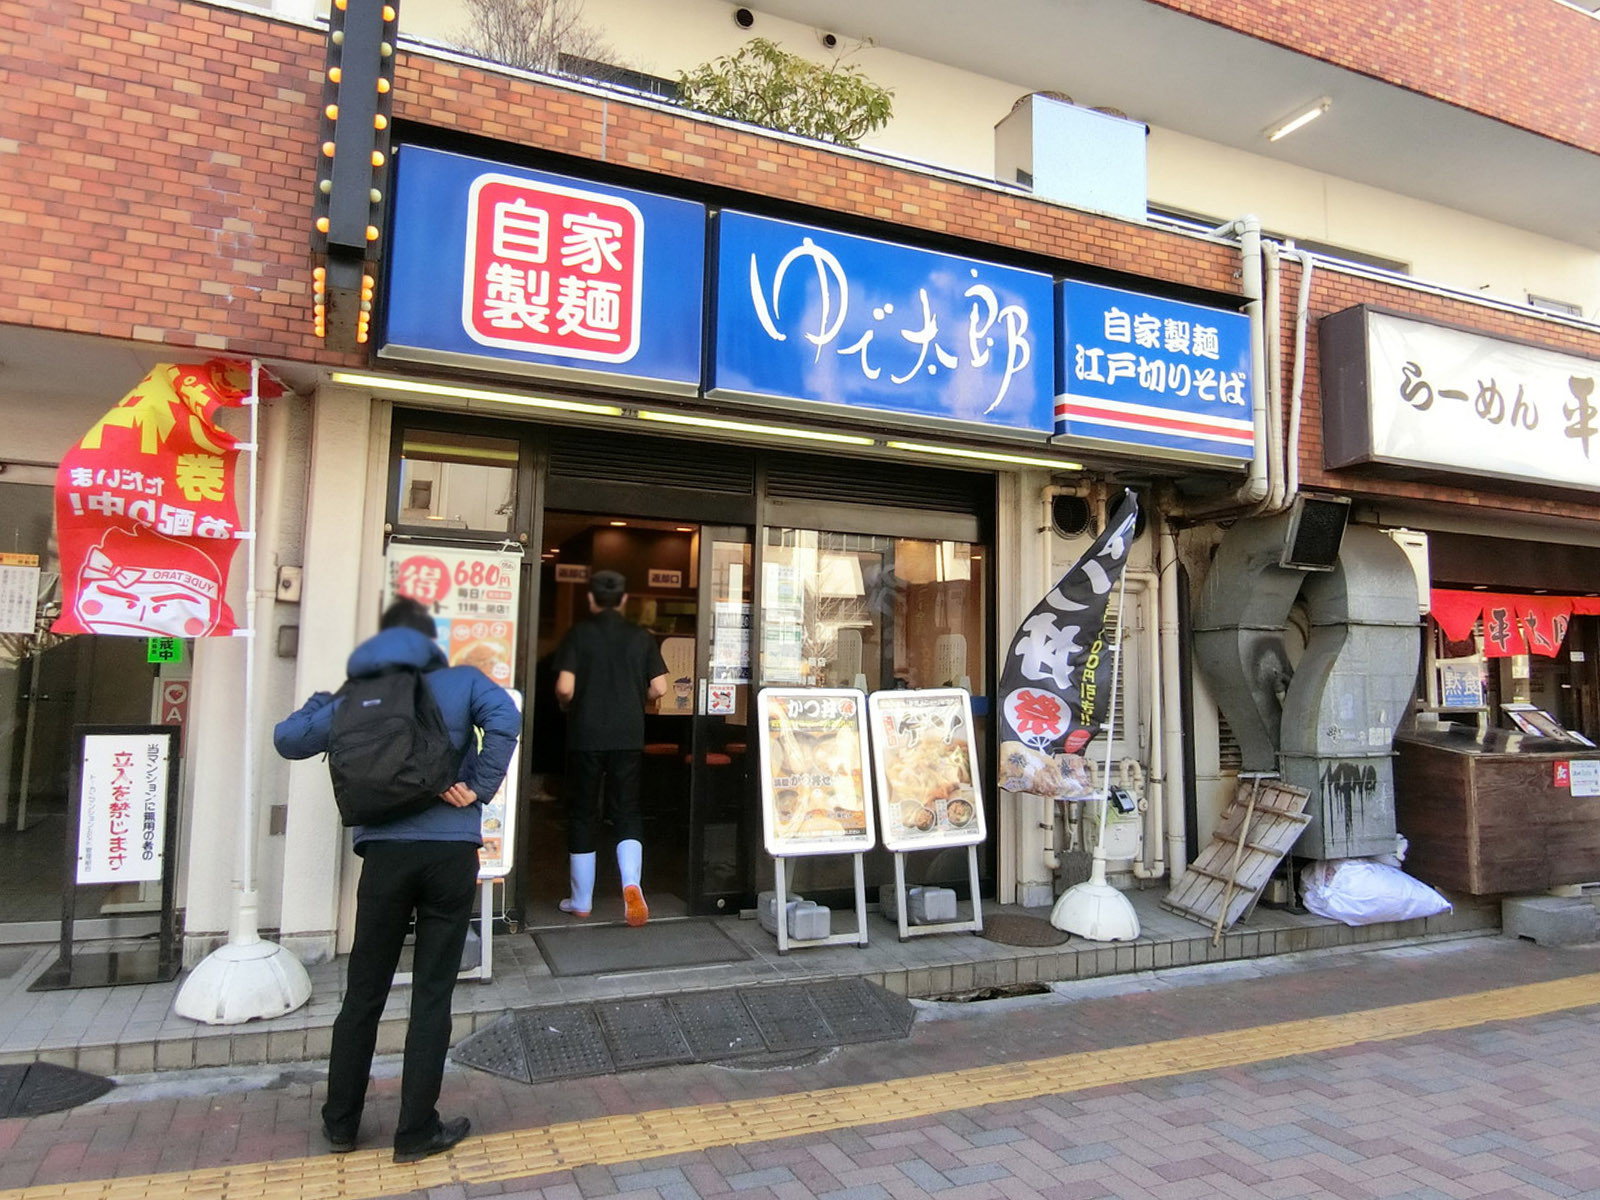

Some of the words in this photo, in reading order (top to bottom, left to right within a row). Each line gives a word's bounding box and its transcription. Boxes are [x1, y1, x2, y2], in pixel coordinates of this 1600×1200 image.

[492, 197, 623, 275] 自家
[482, 261, 623, 342] 製麺
[750, 236, 1032, 415] ゆで太郎
[1103, 306, 1221, 361] 自家製麺
[1075, 343, 1247, 407] 江戸切りそば
[1400, 360, 1539, 431] らーめん
[1444, 671, 1481, 696] 黙食
[108, 751, 134, 871] 立入を禁じます
